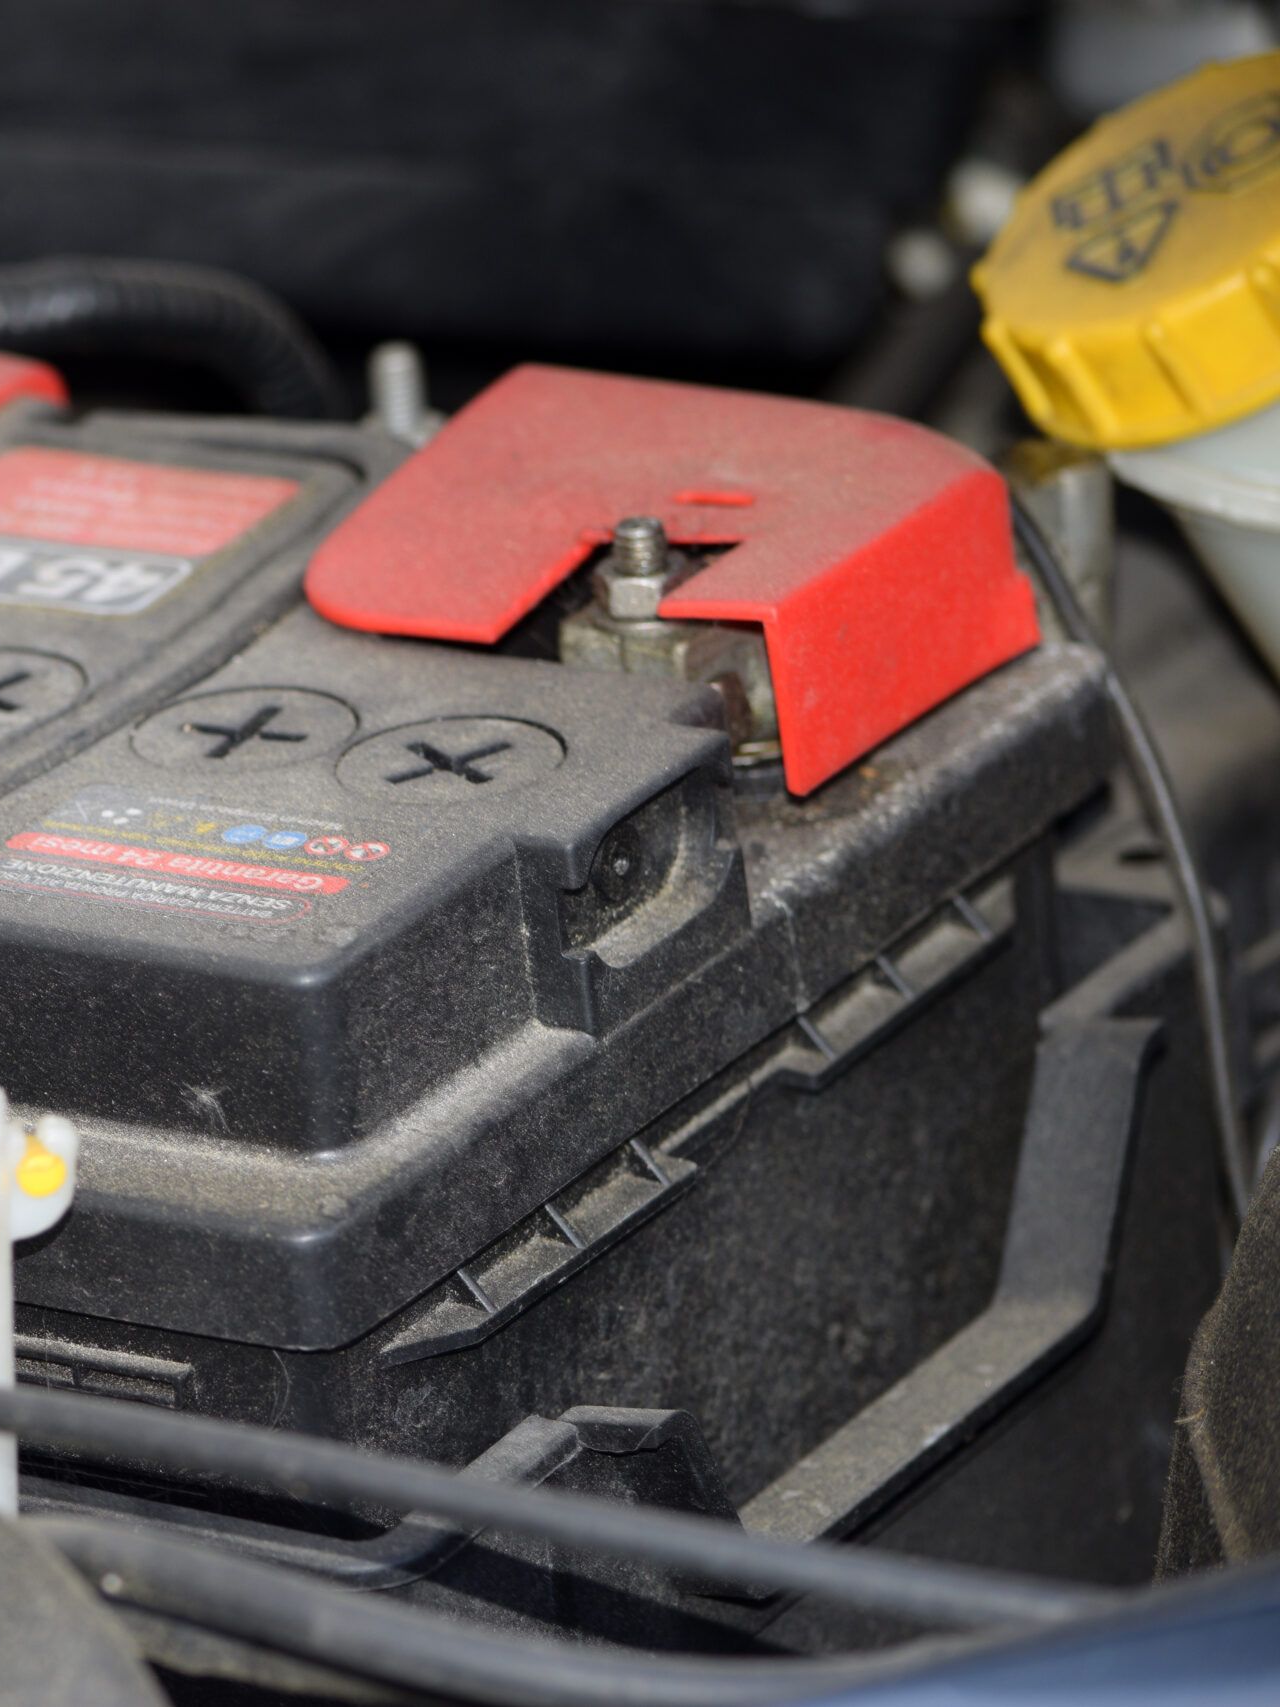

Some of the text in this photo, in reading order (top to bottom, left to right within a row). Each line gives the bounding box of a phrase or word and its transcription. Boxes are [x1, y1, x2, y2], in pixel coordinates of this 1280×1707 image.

[18, 557, 164, 602] 45
[1, 858, 293, 910] SENZA MANUTENZIONE
[32, 836, 324, 890] Garantita 24 mesi
[194, 899, 273, 918] BATTERIA
